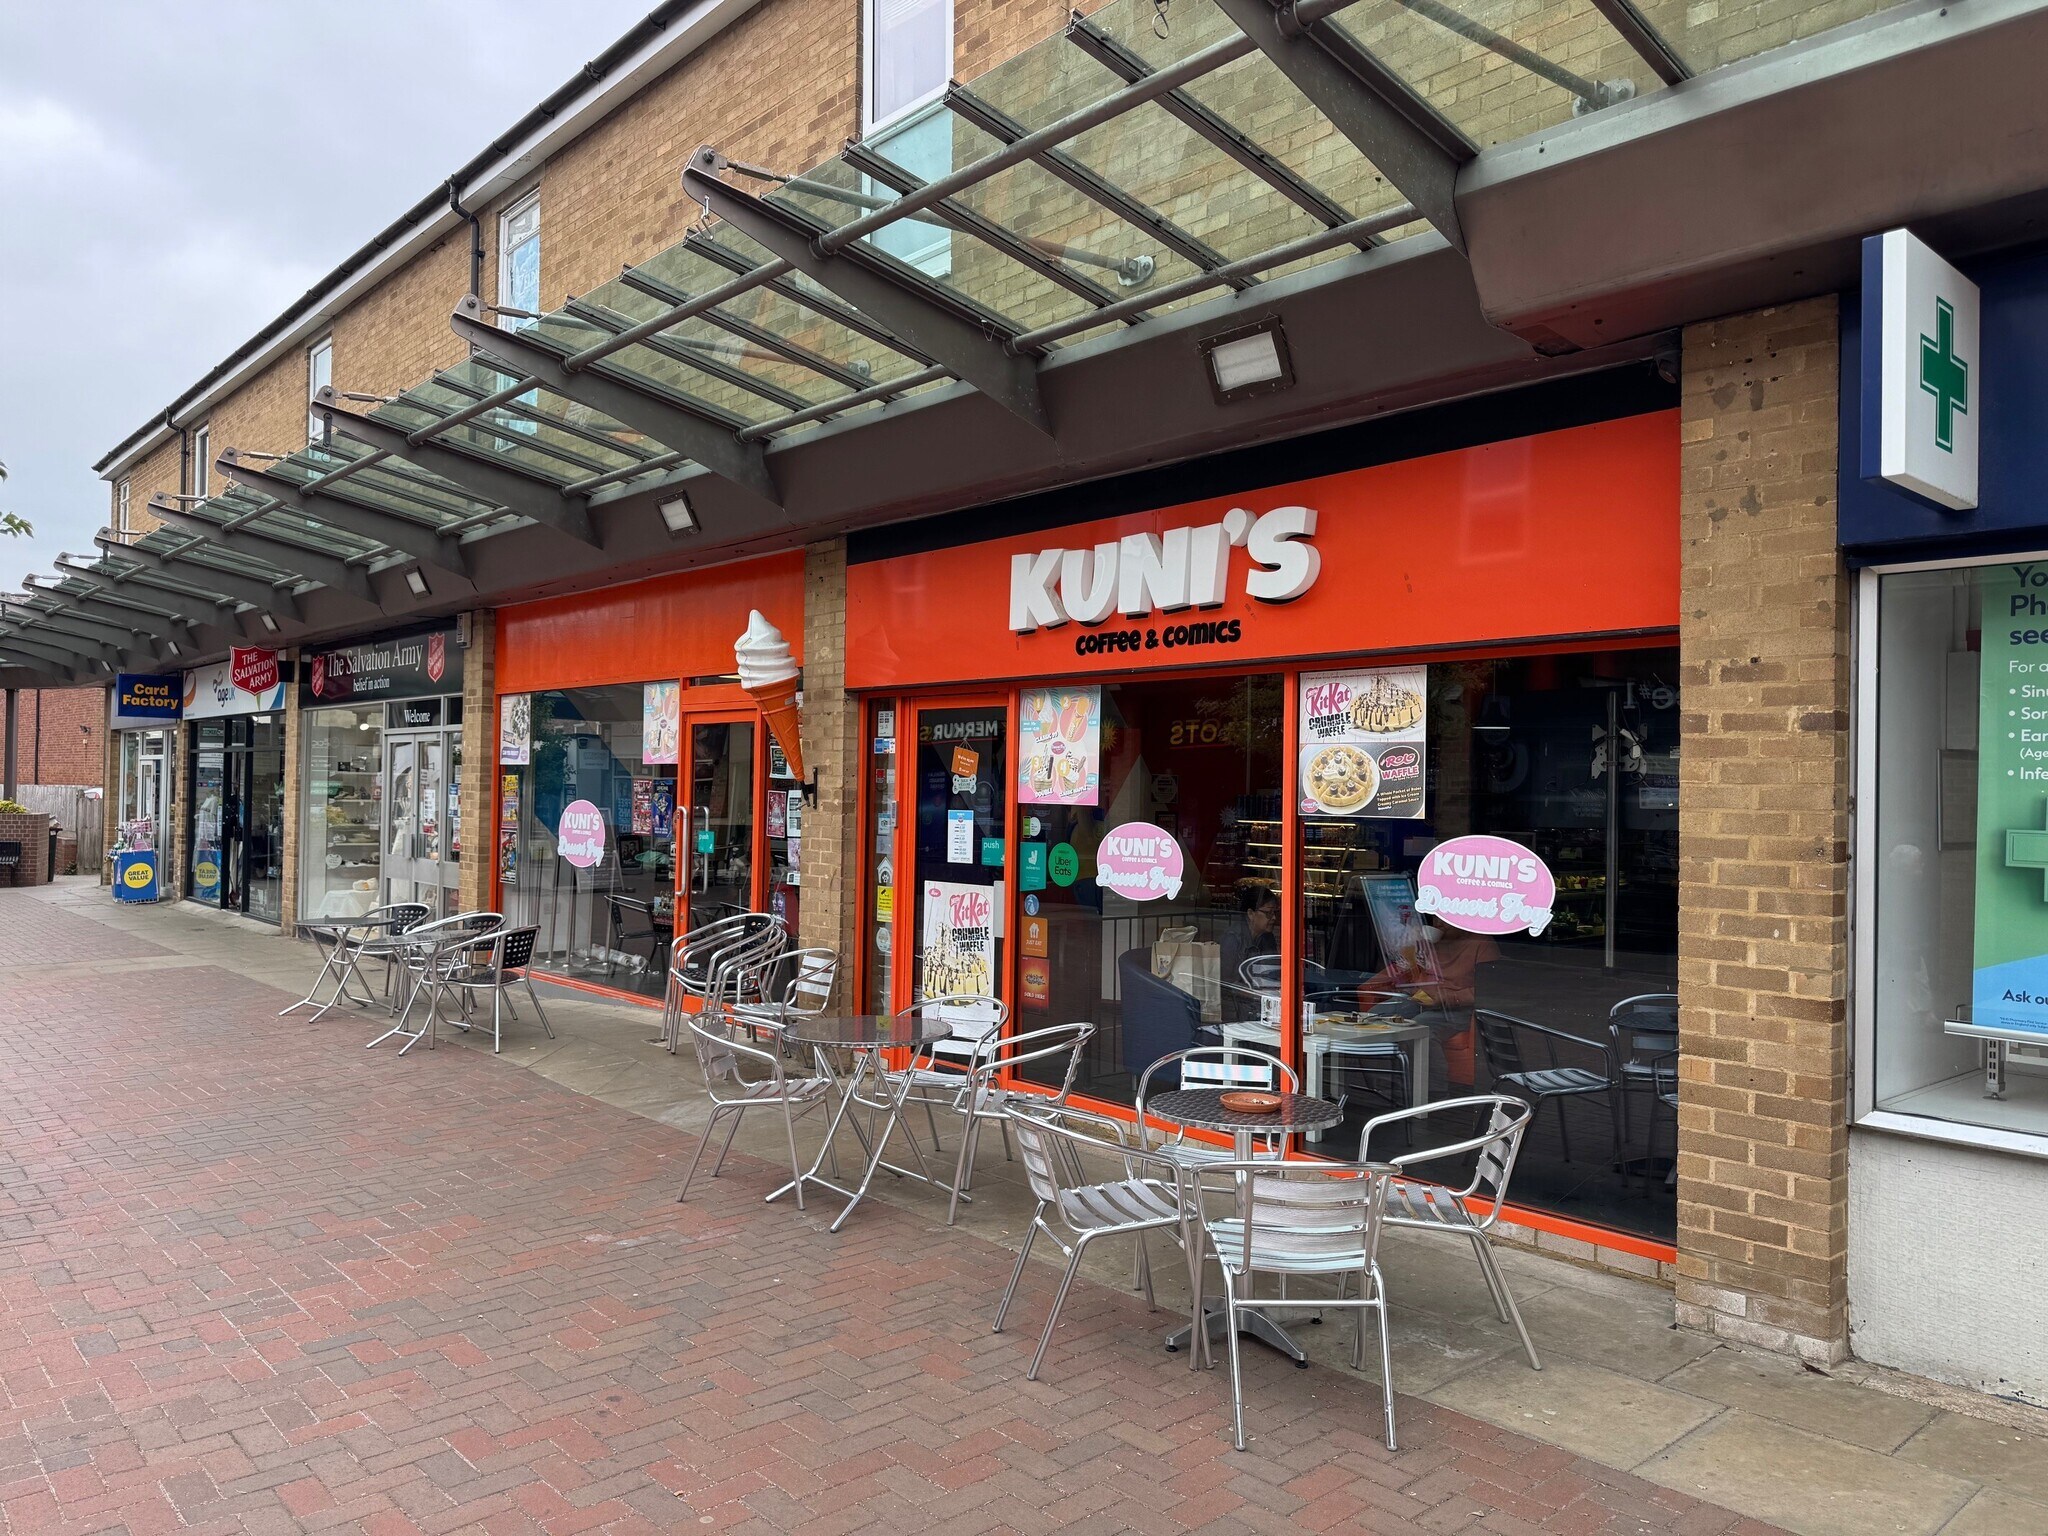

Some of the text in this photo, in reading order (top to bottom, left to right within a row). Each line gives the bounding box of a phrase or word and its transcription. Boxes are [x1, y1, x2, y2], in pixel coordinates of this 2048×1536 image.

[1009, 506, 1321, 634] KUNI'S
[2010, 593, 2048, 617] Ph
[1145, 629, 1159, 650] &
[241, 651, 258, 666] THE
[327, 652, 344, 677] The
[346, 644, 390, 675] Salvation
[392, 641, 423, 672] Army
[234, 655, 275, 682] SALVATION
[2009, 660, 2035, 674] For
[248, 669, 273, 689] ARMY
[353, 674, 390, 692] belief in action
[133, 683, 169, 696] Card
[122, 694, 179, 710] Factory
[1310, 682, 1350, 717] KitKat
[404, 709, 431, 723] Welcome
[2021, 707, 2048, 720] Sor
[1381, 765, 1419, 780] WAFFLE
[564, 811, 600, 831] KUNI'S
[983, 840, 1000, 851] push
[1107, 836, 1173, 858] KUNI'S
[1054, 856, 1072, 867] Uber
[1433, 851, 1538, 883] KUNI'S
[127, 868, 149, 877] GREAT
[128, 873, 150, 881] VALUE
[1054, 866, 1072, 876] Eats
[952, 892, 989, 928] KitKat
[2002, 989, 2031, 1004] Ask
